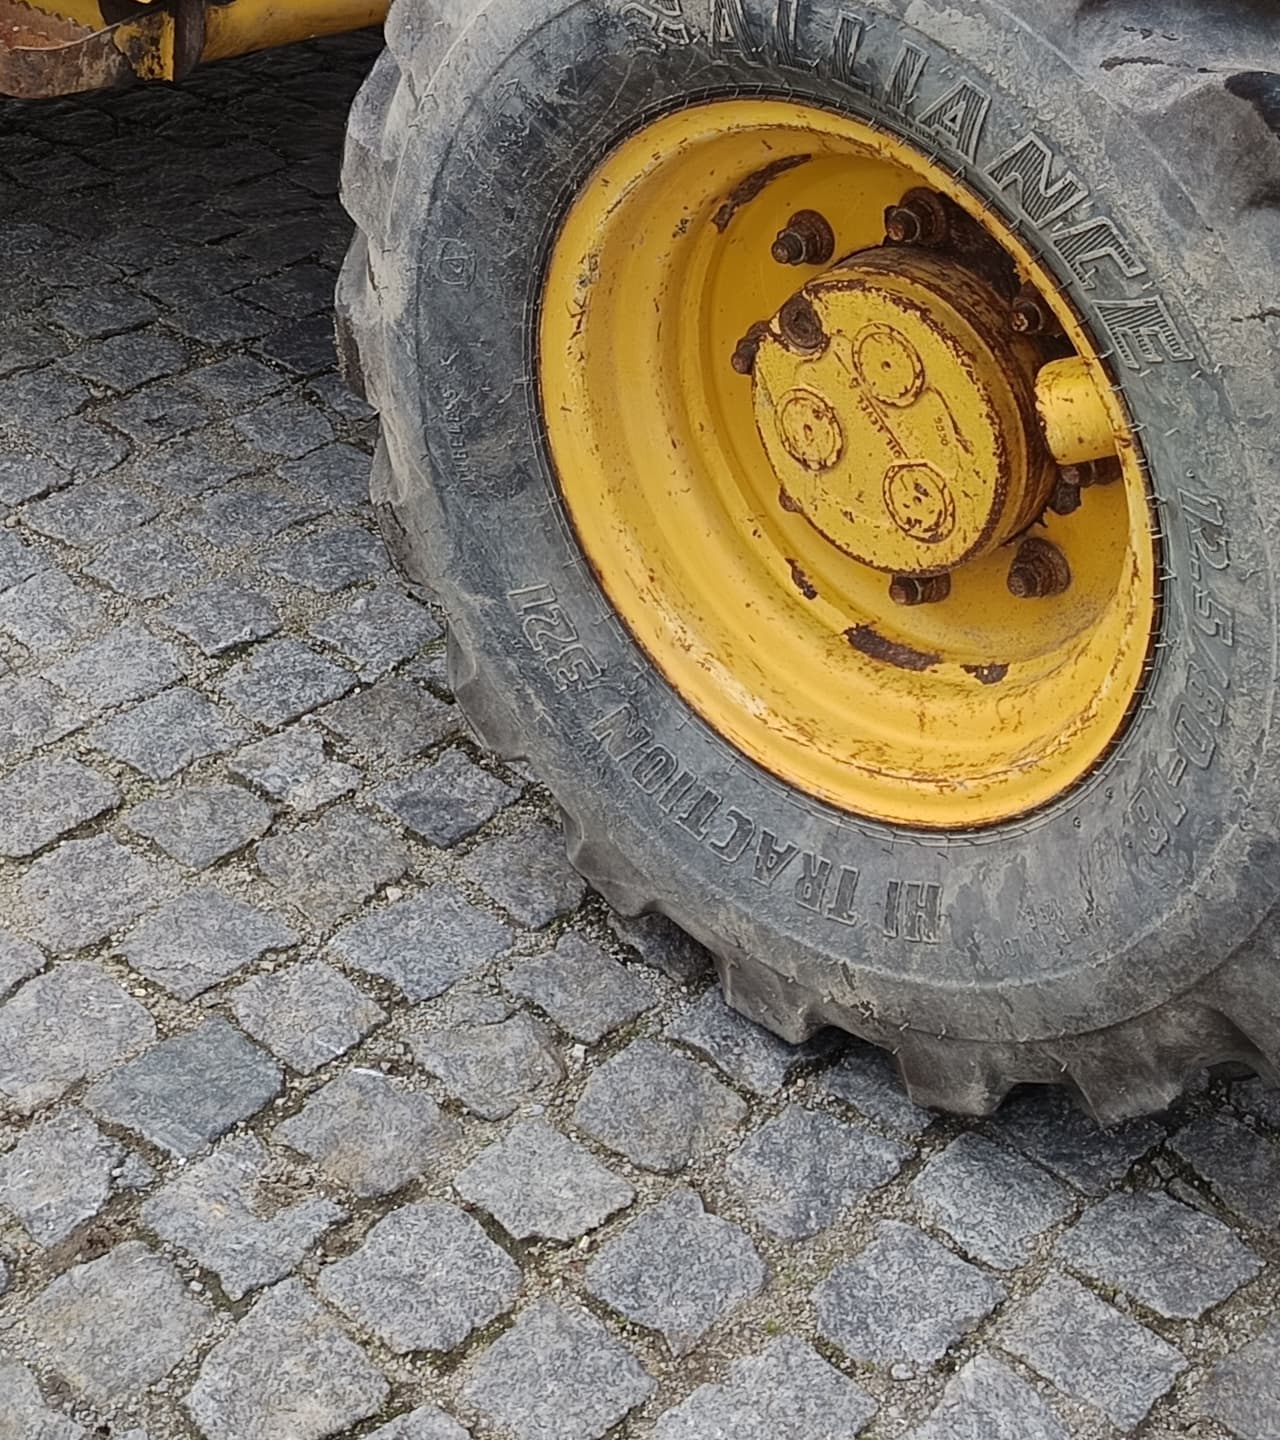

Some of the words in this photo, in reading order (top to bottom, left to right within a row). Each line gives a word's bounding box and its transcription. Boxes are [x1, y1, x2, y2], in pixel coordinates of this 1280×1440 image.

[506, 583, 608, 694] 321
[591, 701, 860, 927] TRACTION
[882, 879, 945, 944] HI
